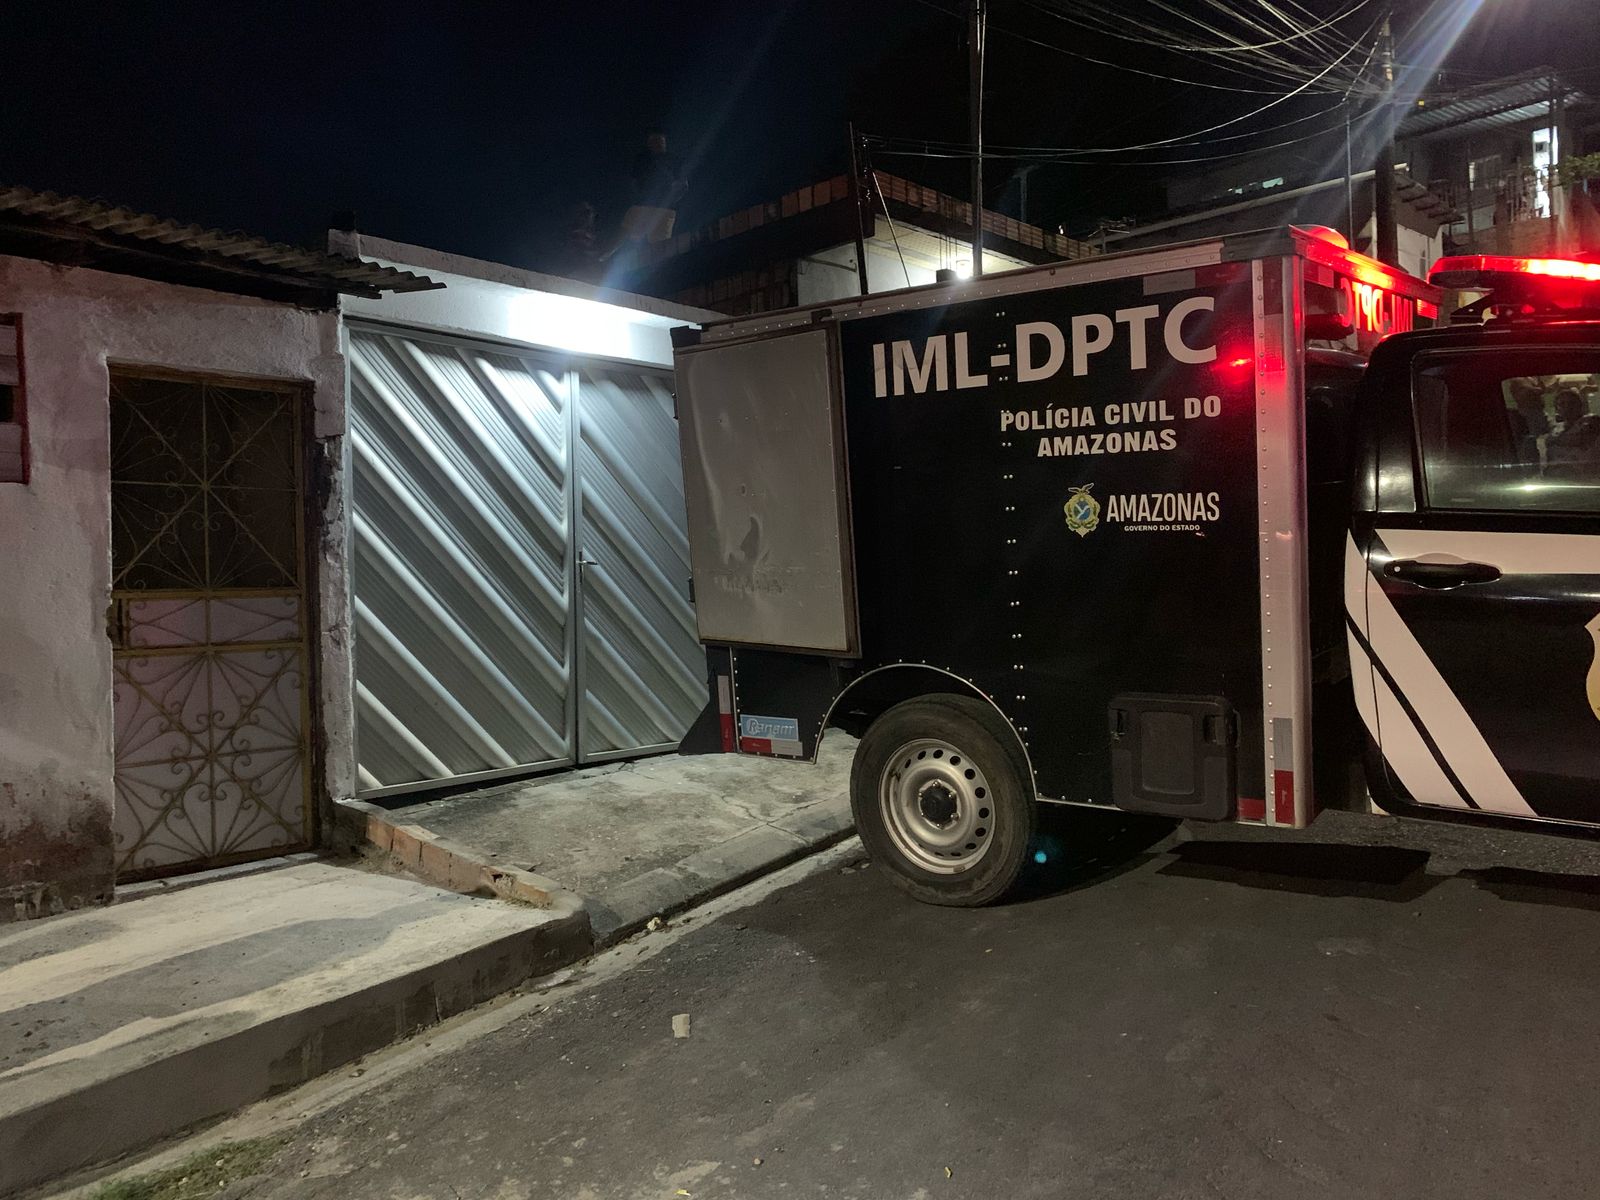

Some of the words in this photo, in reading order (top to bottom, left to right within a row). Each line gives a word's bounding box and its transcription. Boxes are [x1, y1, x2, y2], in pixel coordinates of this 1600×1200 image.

[872, 296, 1218, 398] IML-DPTC
[1001, 403, 1096, 432] POLÍCIA
[1104, 400, 1174, 425] CIVIL
[1184, 395, 1221, 419] DO
[1037, 428, 1177, 457] AMAZONAS
[1106, 491, 1220, 522] AMAZONAS
